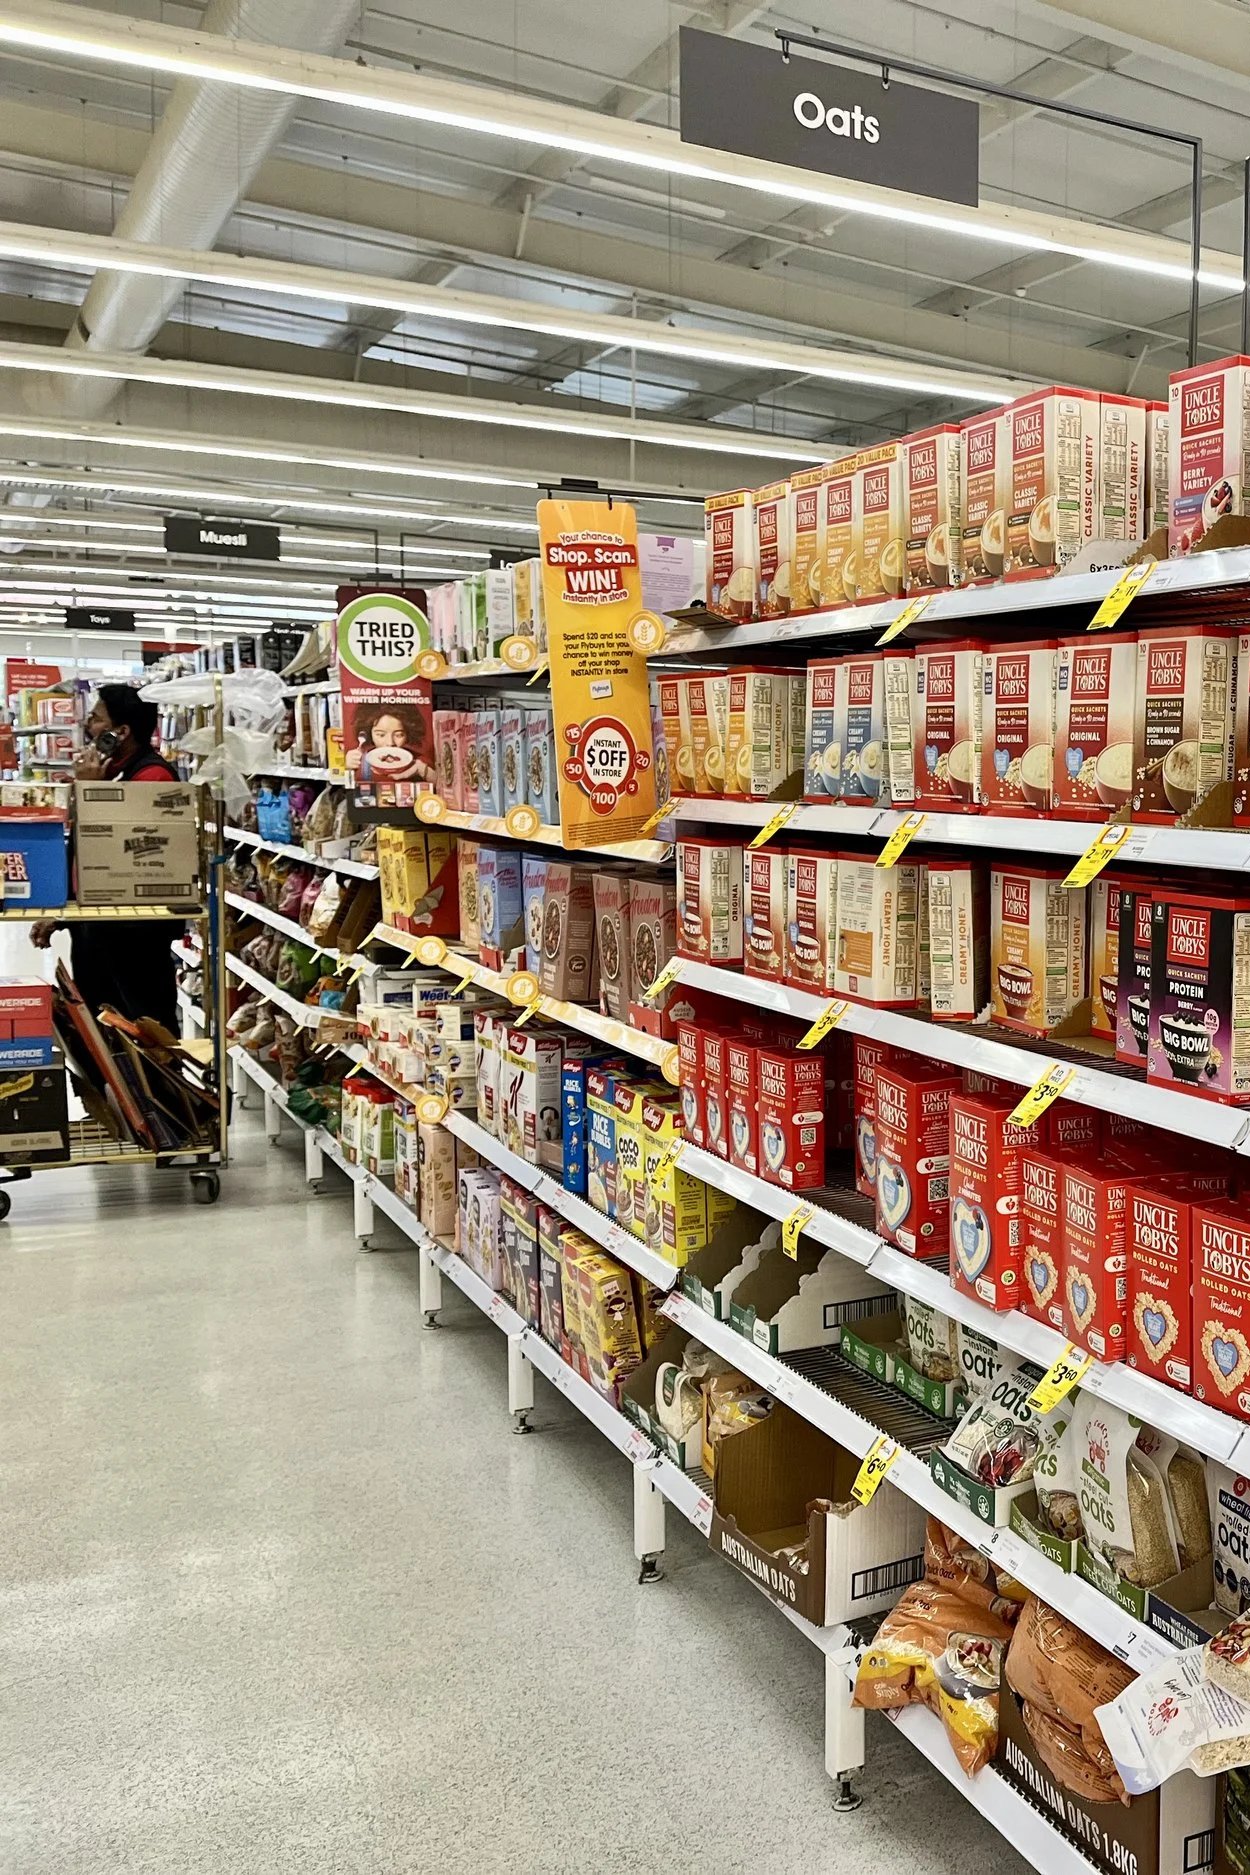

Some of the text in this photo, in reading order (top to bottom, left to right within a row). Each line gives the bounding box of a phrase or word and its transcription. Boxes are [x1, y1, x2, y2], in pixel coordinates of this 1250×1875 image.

[793, 92, 879, 143] Oats
[200, 530, 247, 547] Muesli
[561, 532, 622, 544] Your chance to
[550, 547, 635, 566] Shop. Scan.
[568, 569, 617, 592] WIN!
[563, 591, 627, 604] Instantly in store
[90, 615, 110, 625] Toys
[355, 622, 414, 638] TRIED
[563, 633, 584, 641] Spend
[357, 640, 414, 656] THIS?
[604, 659, 620, 667] shop
[571, 668, 603, 676] INSTANTLY
[594, 739, 621, 748] INSTANT
[1070, 731, 1101, 742] ORIGINAL
[587, 746, 627, 767] $ OFF
[566, 763, 582, 774] $50
[601, 769, 621, 777] STORE
[592, 792, 614, 804] $100
[593, 1113, 608, 1135] RICE
[591, 1129, 611, 1149] BUBBLES
[619, 1138, 638, 1156] COCO
[720, 1531, 796, 1602] AUSTRALIAN OATS
[1103, 1833, 1139, 1875] 1.8KG
